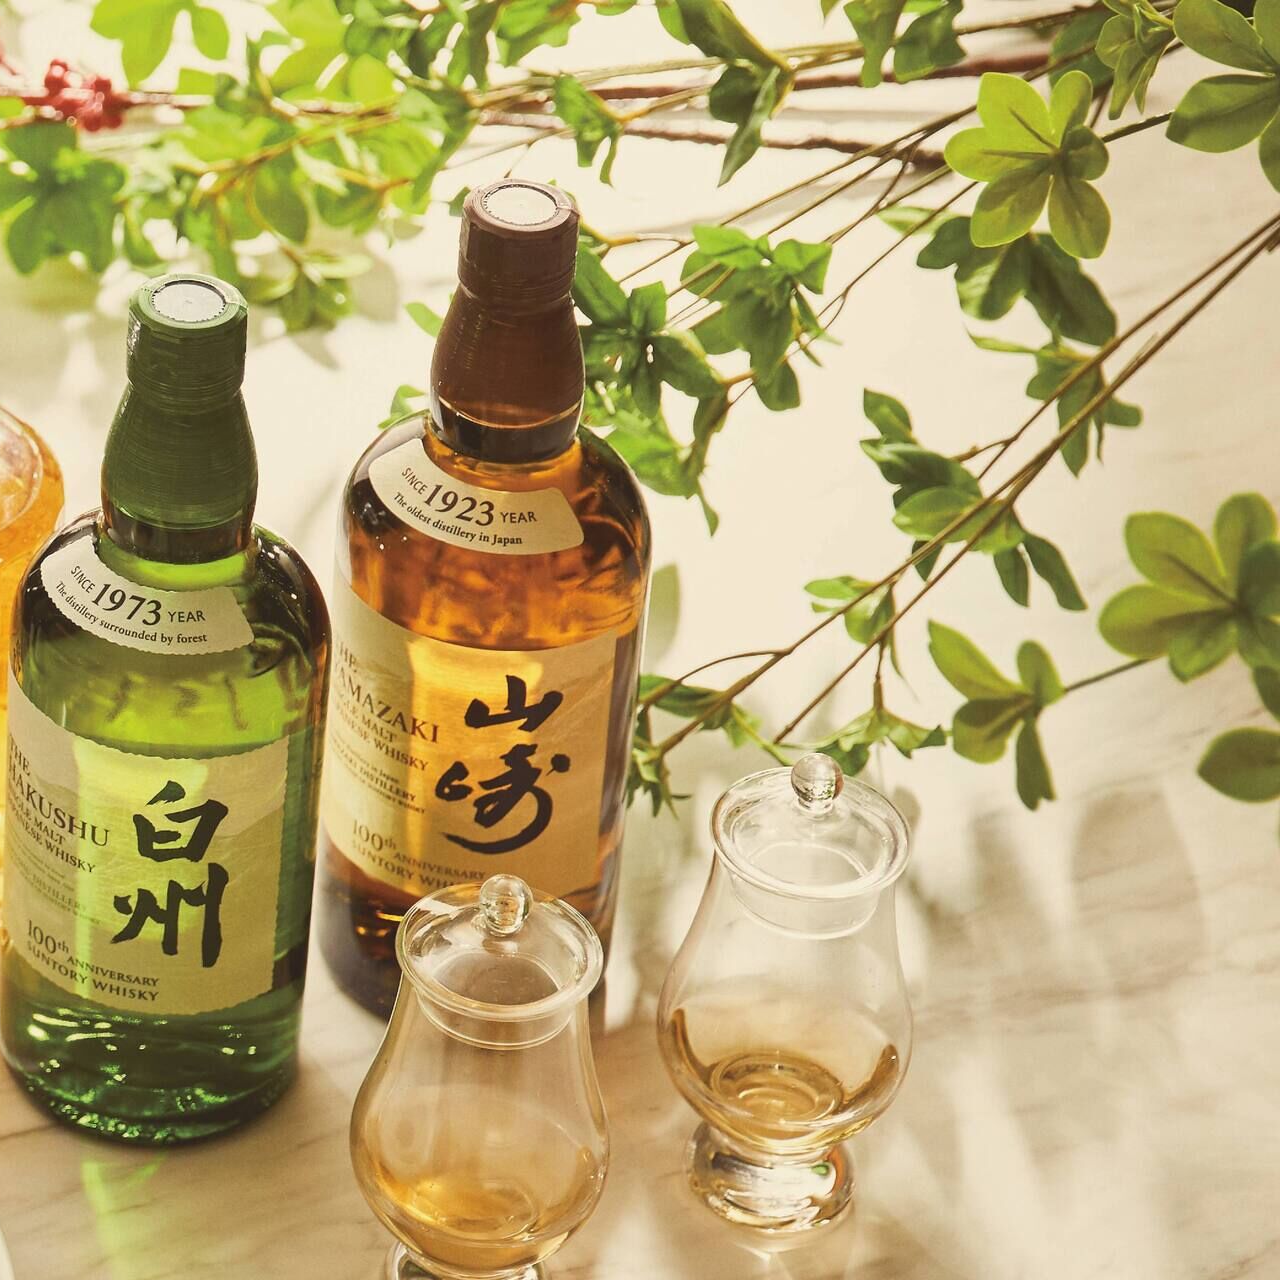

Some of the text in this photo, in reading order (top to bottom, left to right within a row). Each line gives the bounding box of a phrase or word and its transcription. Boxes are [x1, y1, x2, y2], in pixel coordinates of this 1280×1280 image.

[401, 467, 538, 527] SINCE 1923 YEAR
[393, 492, 523, 548] The oldest distillery in Japan
[55, 580, 208, 646] The distillery surrounded by forest
[70, 565, 206, 626] SINCE 1973 YEAR
[335, 662, 439, 744] AMAZAKI
[361, 714, 397, 743] MALT
[374, 737, 429, 771] WHISKY
[435, 674, 571, 855] 山崎
[8, 754, 110, 847] HAKUSHU
[34, 816, 66, 845] MALT
[353, 819, 397, 851] 100th
[44, 838, 95, 873] WHISKY
[394, 851, 486, 880] ANNIVERSARY
[110, 780, 230, 969] 白州
[27, 919, 69, 954] 100th
[67, 955, 159, 988] ANNIVERSARY
[92, 979, 160, 1001] WHISKY
